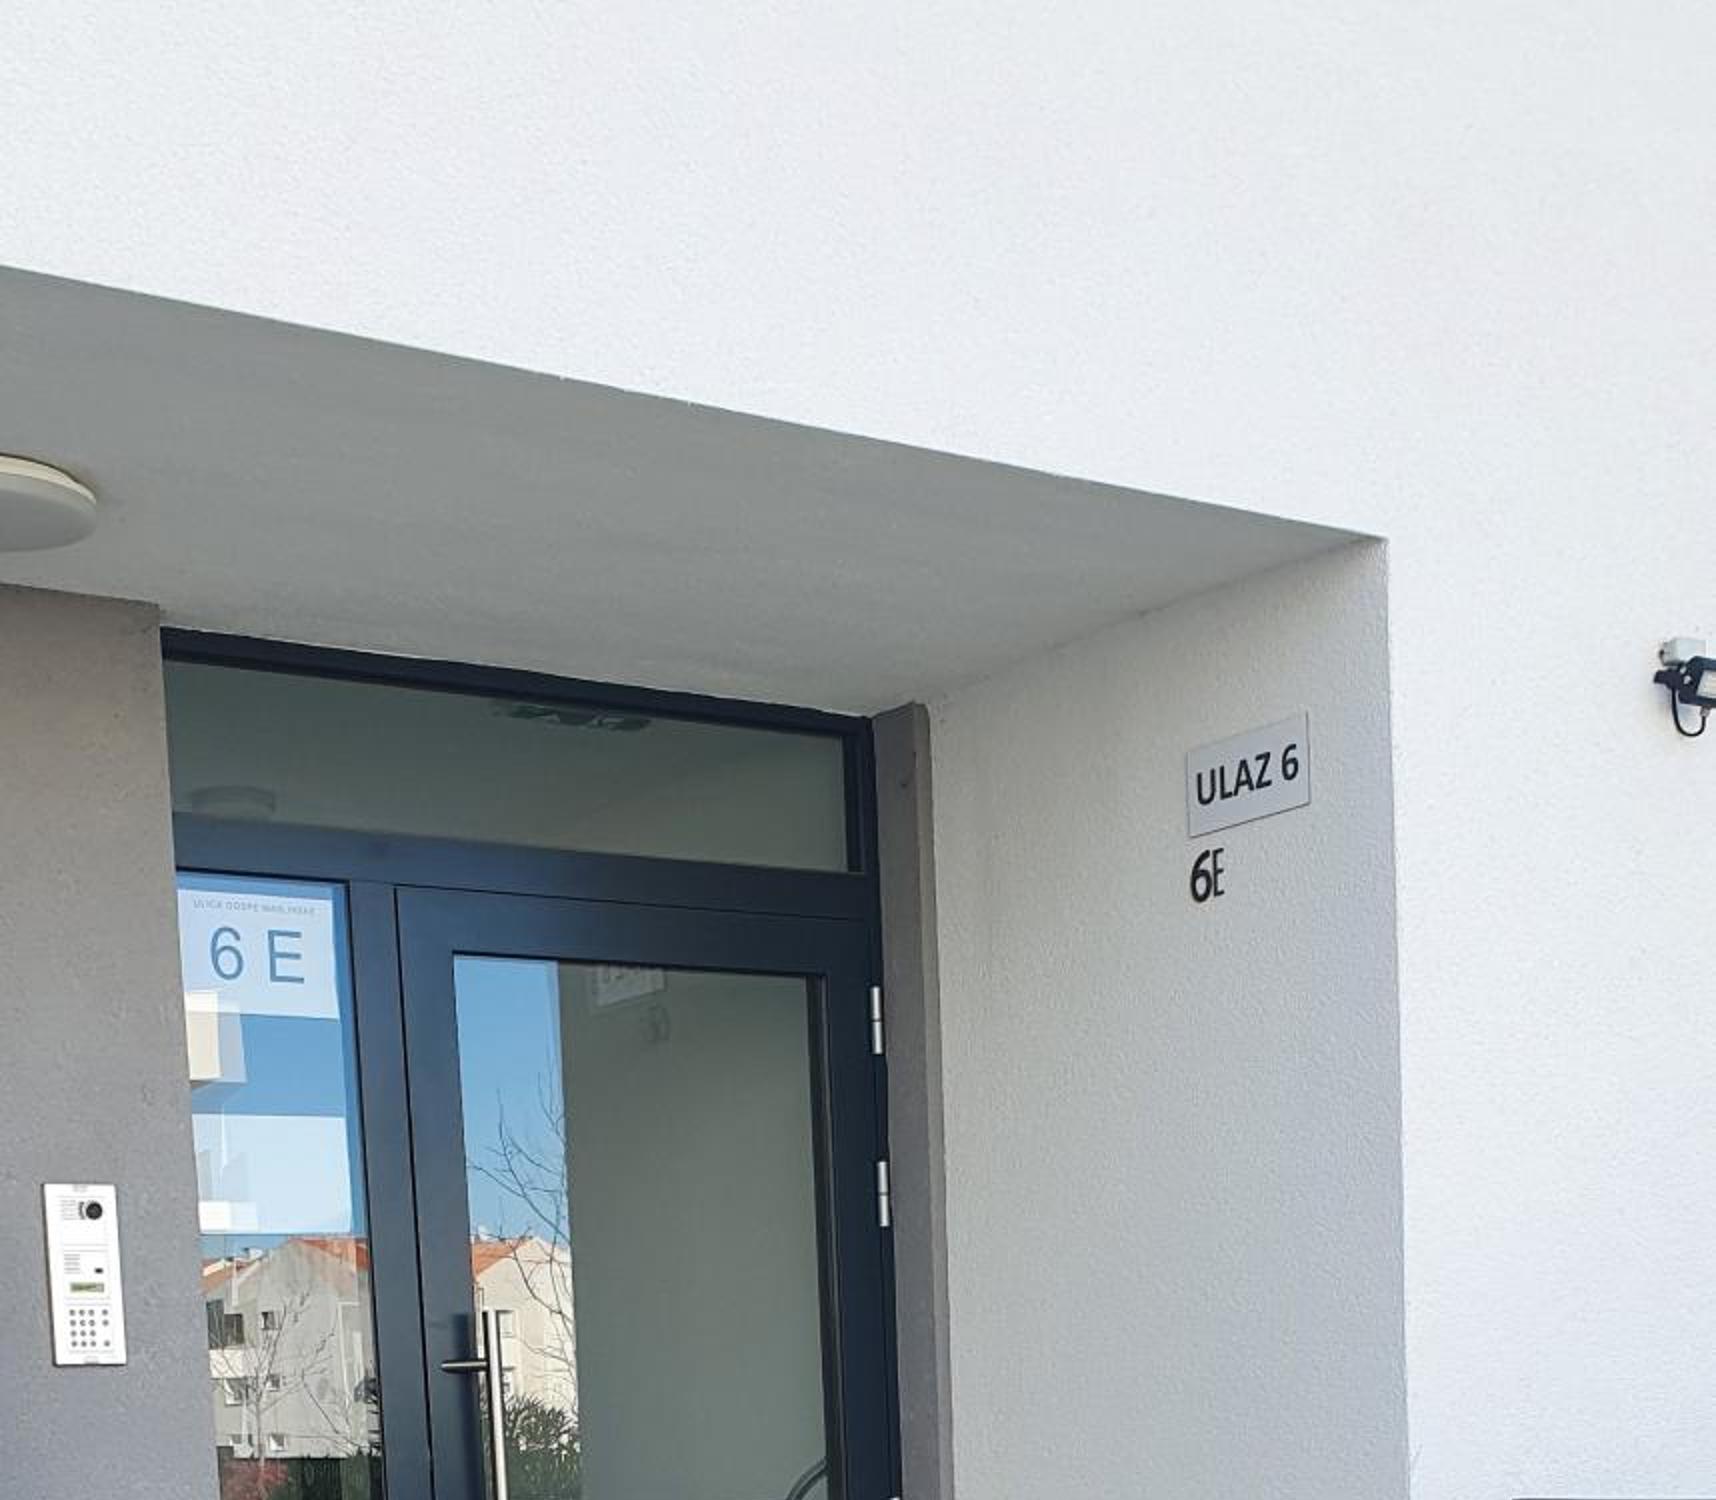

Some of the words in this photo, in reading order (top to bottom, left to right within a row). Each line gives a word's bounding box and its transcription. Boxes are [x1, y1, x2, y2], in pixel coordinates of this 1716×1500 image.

[1197, 751, 1272, 805] ULAZ
[1281, 744, 1299, 781] 6
[1190, 847, 1225, 903] 6E
[210, 926, 244, 981] 6
[267, 929, 305, 984] E
